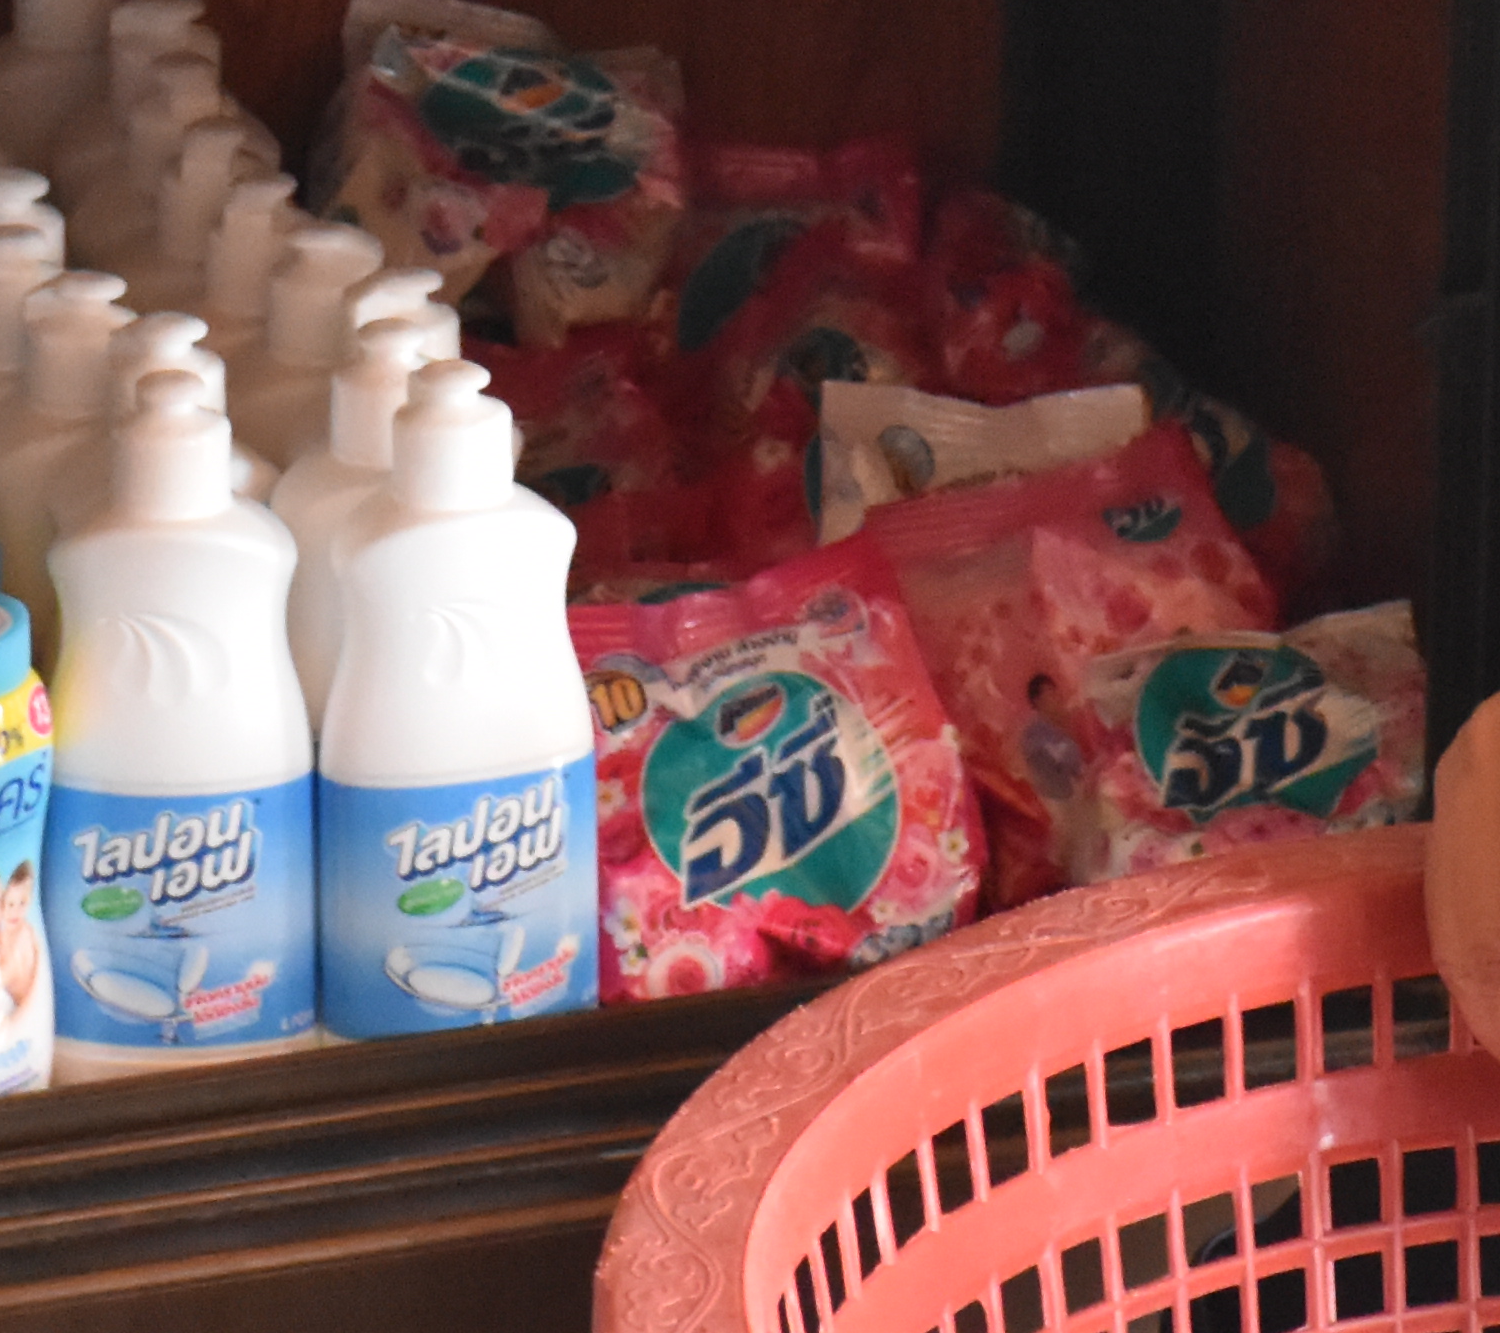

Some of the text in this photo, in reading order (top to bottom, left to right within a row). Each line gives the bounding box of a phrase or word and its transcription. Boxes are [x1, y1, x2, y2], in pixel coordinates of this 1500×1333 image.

[72, 799, 244, 883] ไลปอน
[148, 829, 256, 905] เอฟ
[386, 777, 556, 881] ไลปอน
[468, 804, 564, 892] เอฟ
